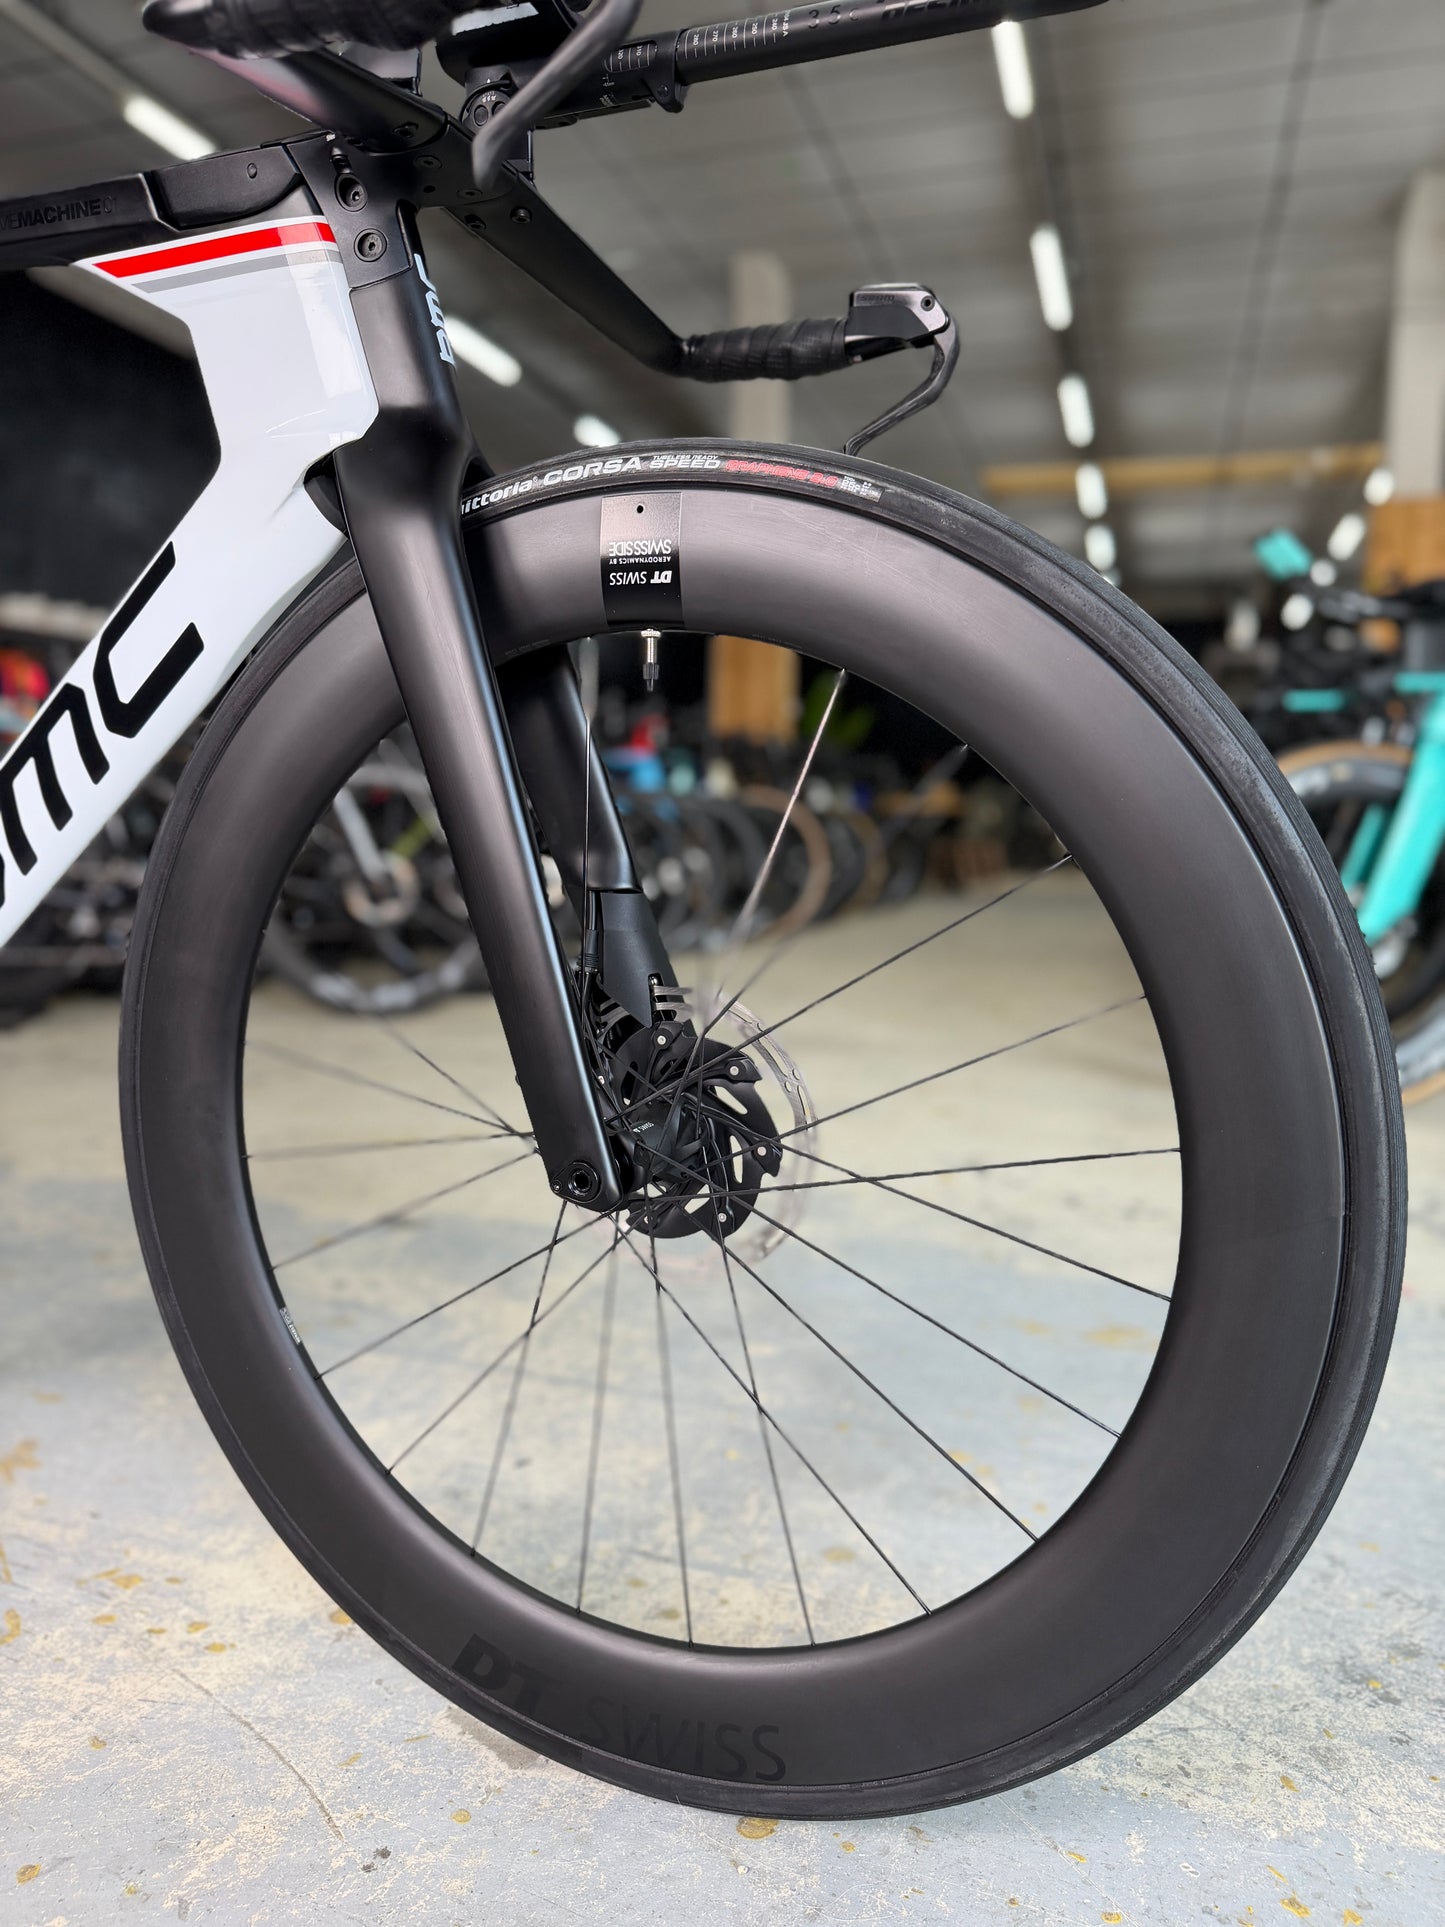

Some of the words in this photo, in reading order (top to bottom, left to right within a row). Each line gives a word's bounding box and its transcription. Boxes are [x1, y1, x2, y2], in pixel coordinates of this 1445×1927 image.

[543, 456, 642, 486] CORSA
[650, 459, 721, 469] SPEED
[618, 556, 672, 565] AERODYNAMICS
[609, 571, 648, 586] SWISS
[650, 570, 673, 584] DT
[451, 1633, 566, 1717] DT
[579, 1694, 787, 1782] SWISS
